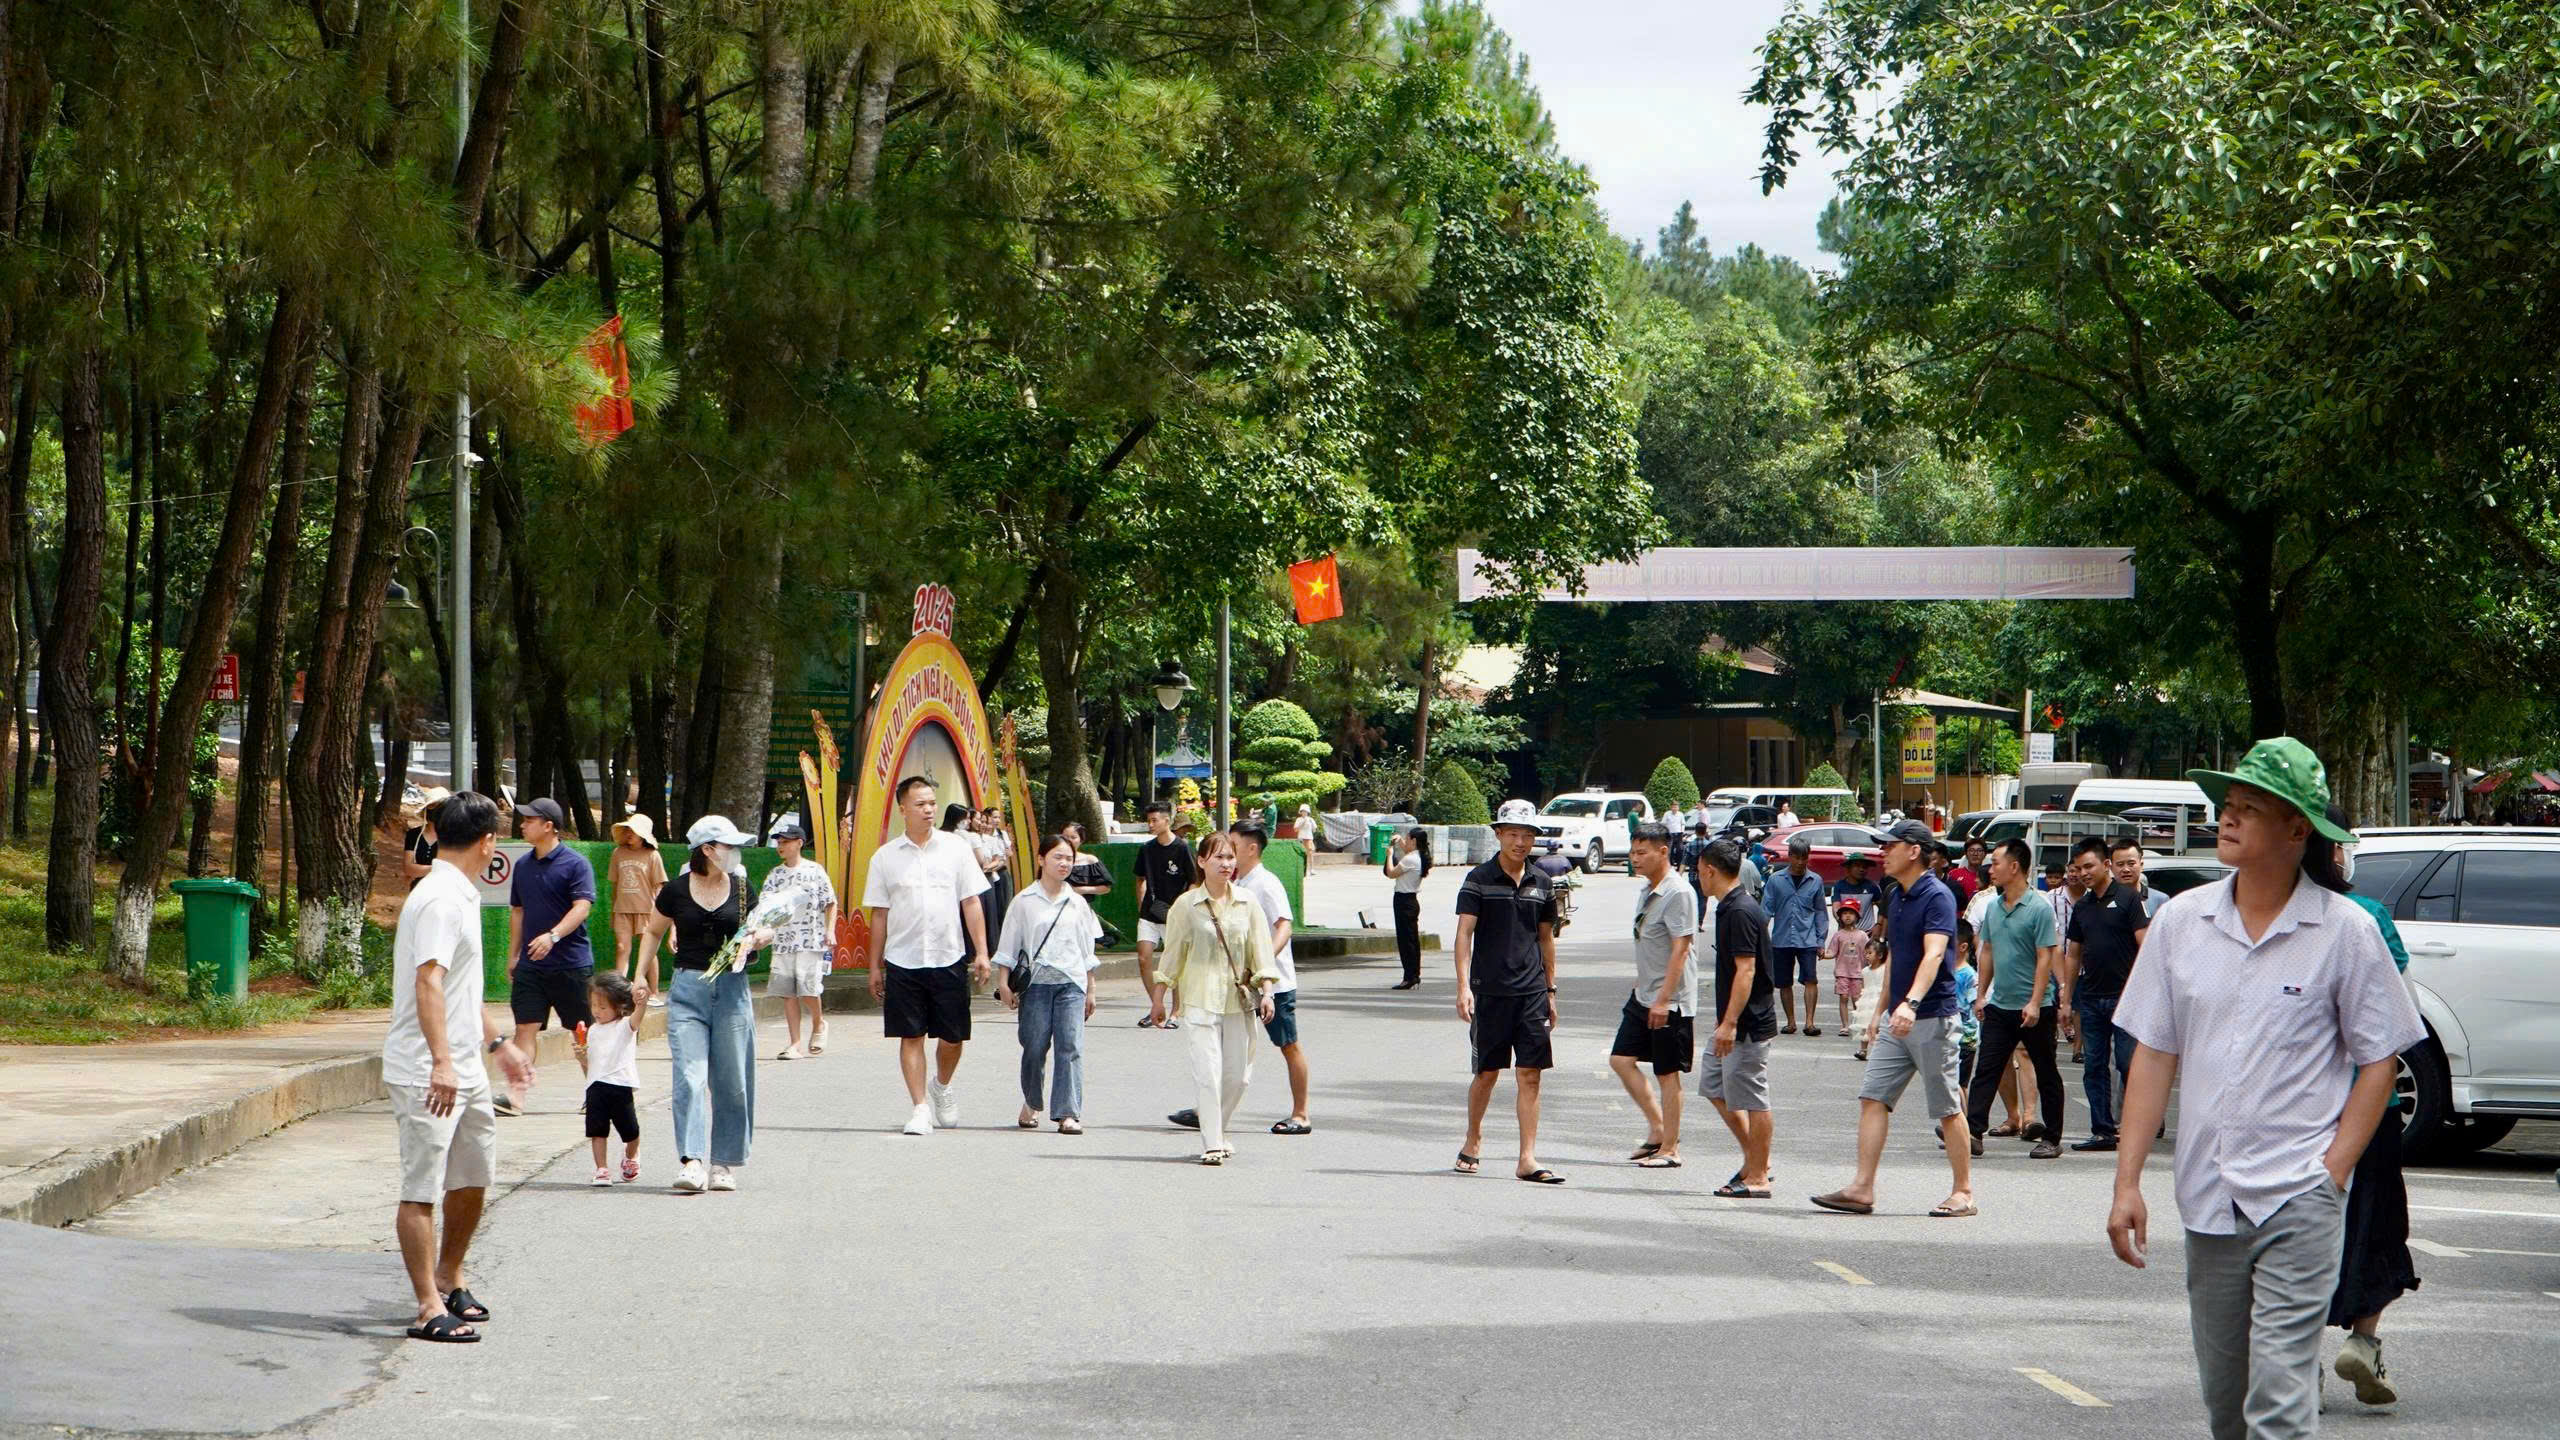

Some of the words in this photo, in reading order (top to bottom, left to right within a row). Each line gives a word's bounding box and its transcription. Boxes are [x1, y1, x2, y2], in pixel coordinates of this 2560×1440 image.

[913, 582, 955, 639] 2025
[223, 674, 232, 684] XE
[217, 685, 234, 699] CHỖ
[876, 724, 895, 788] KHU
[891, 698, 904, 738] DI
[903, 671, 922, 720] TÍCH
[923, 661, 941, 699] NGÃ
[943, 670, 954, 711] BA
[954, 689, 977, 751] ĐỒNG
[974, 740, 990, 796] LỘC
[1905, 744, 1918, 761] ĐỒ
[1921, 744, 1933, 761] LỄ
